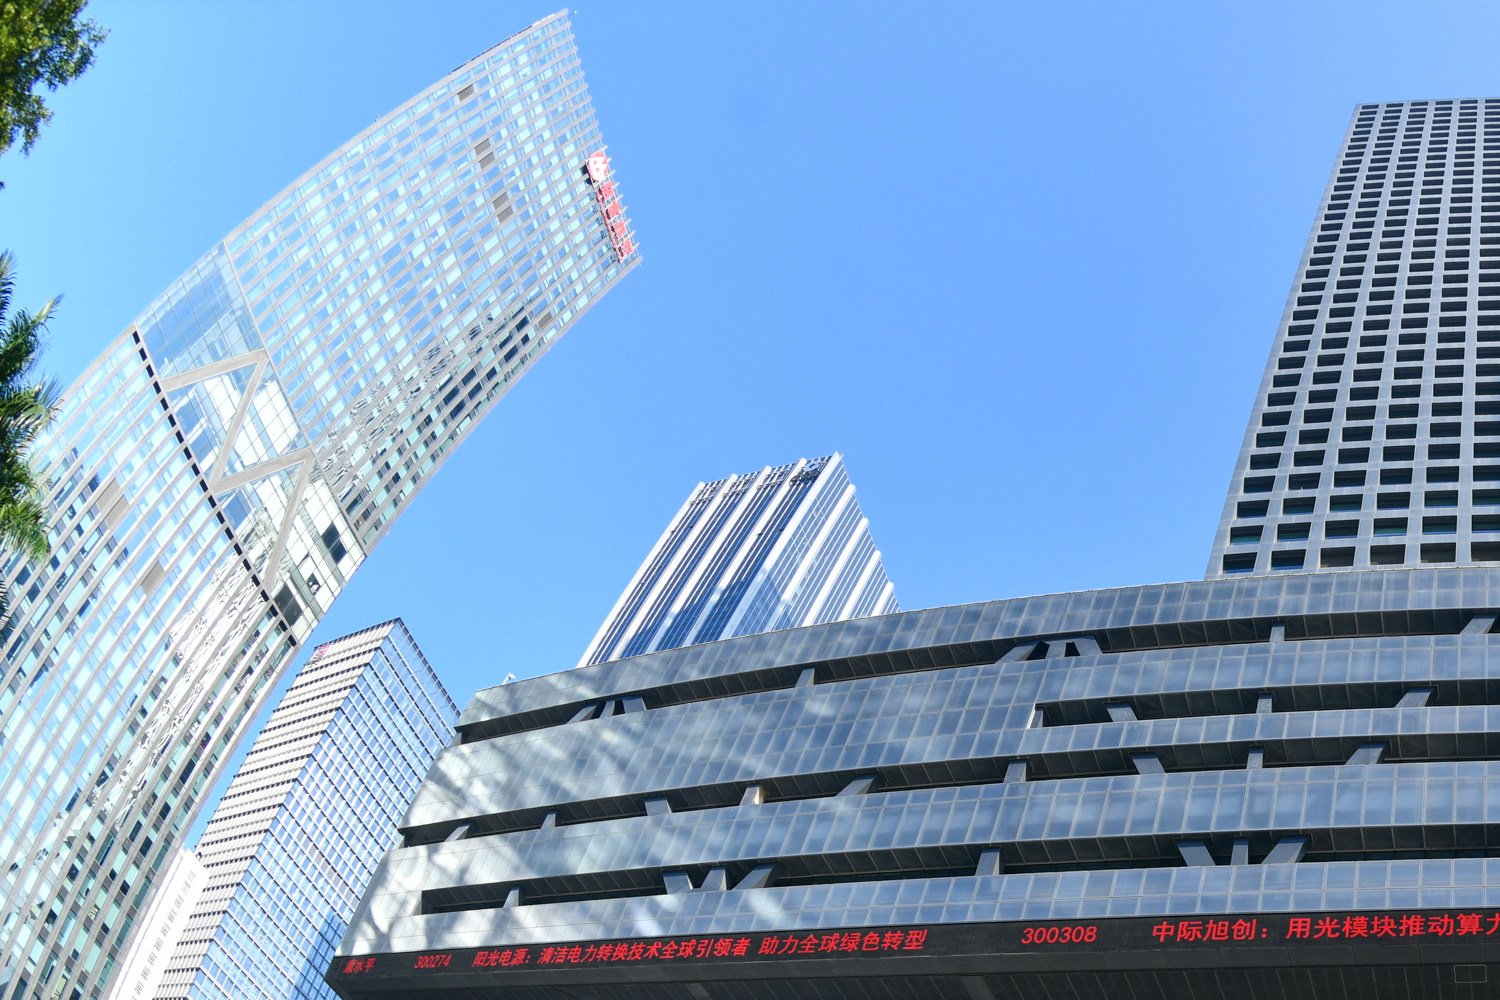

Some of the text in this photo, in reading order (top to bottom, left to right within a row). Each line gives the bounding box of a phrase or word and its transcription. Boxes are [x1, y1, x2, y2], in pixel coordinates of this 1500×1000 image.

[414, 953, 452, 969] 300274
[758, 929, 928, 954] 助力全球绿色转型
[1020, 925, 1098, 944] 300308
